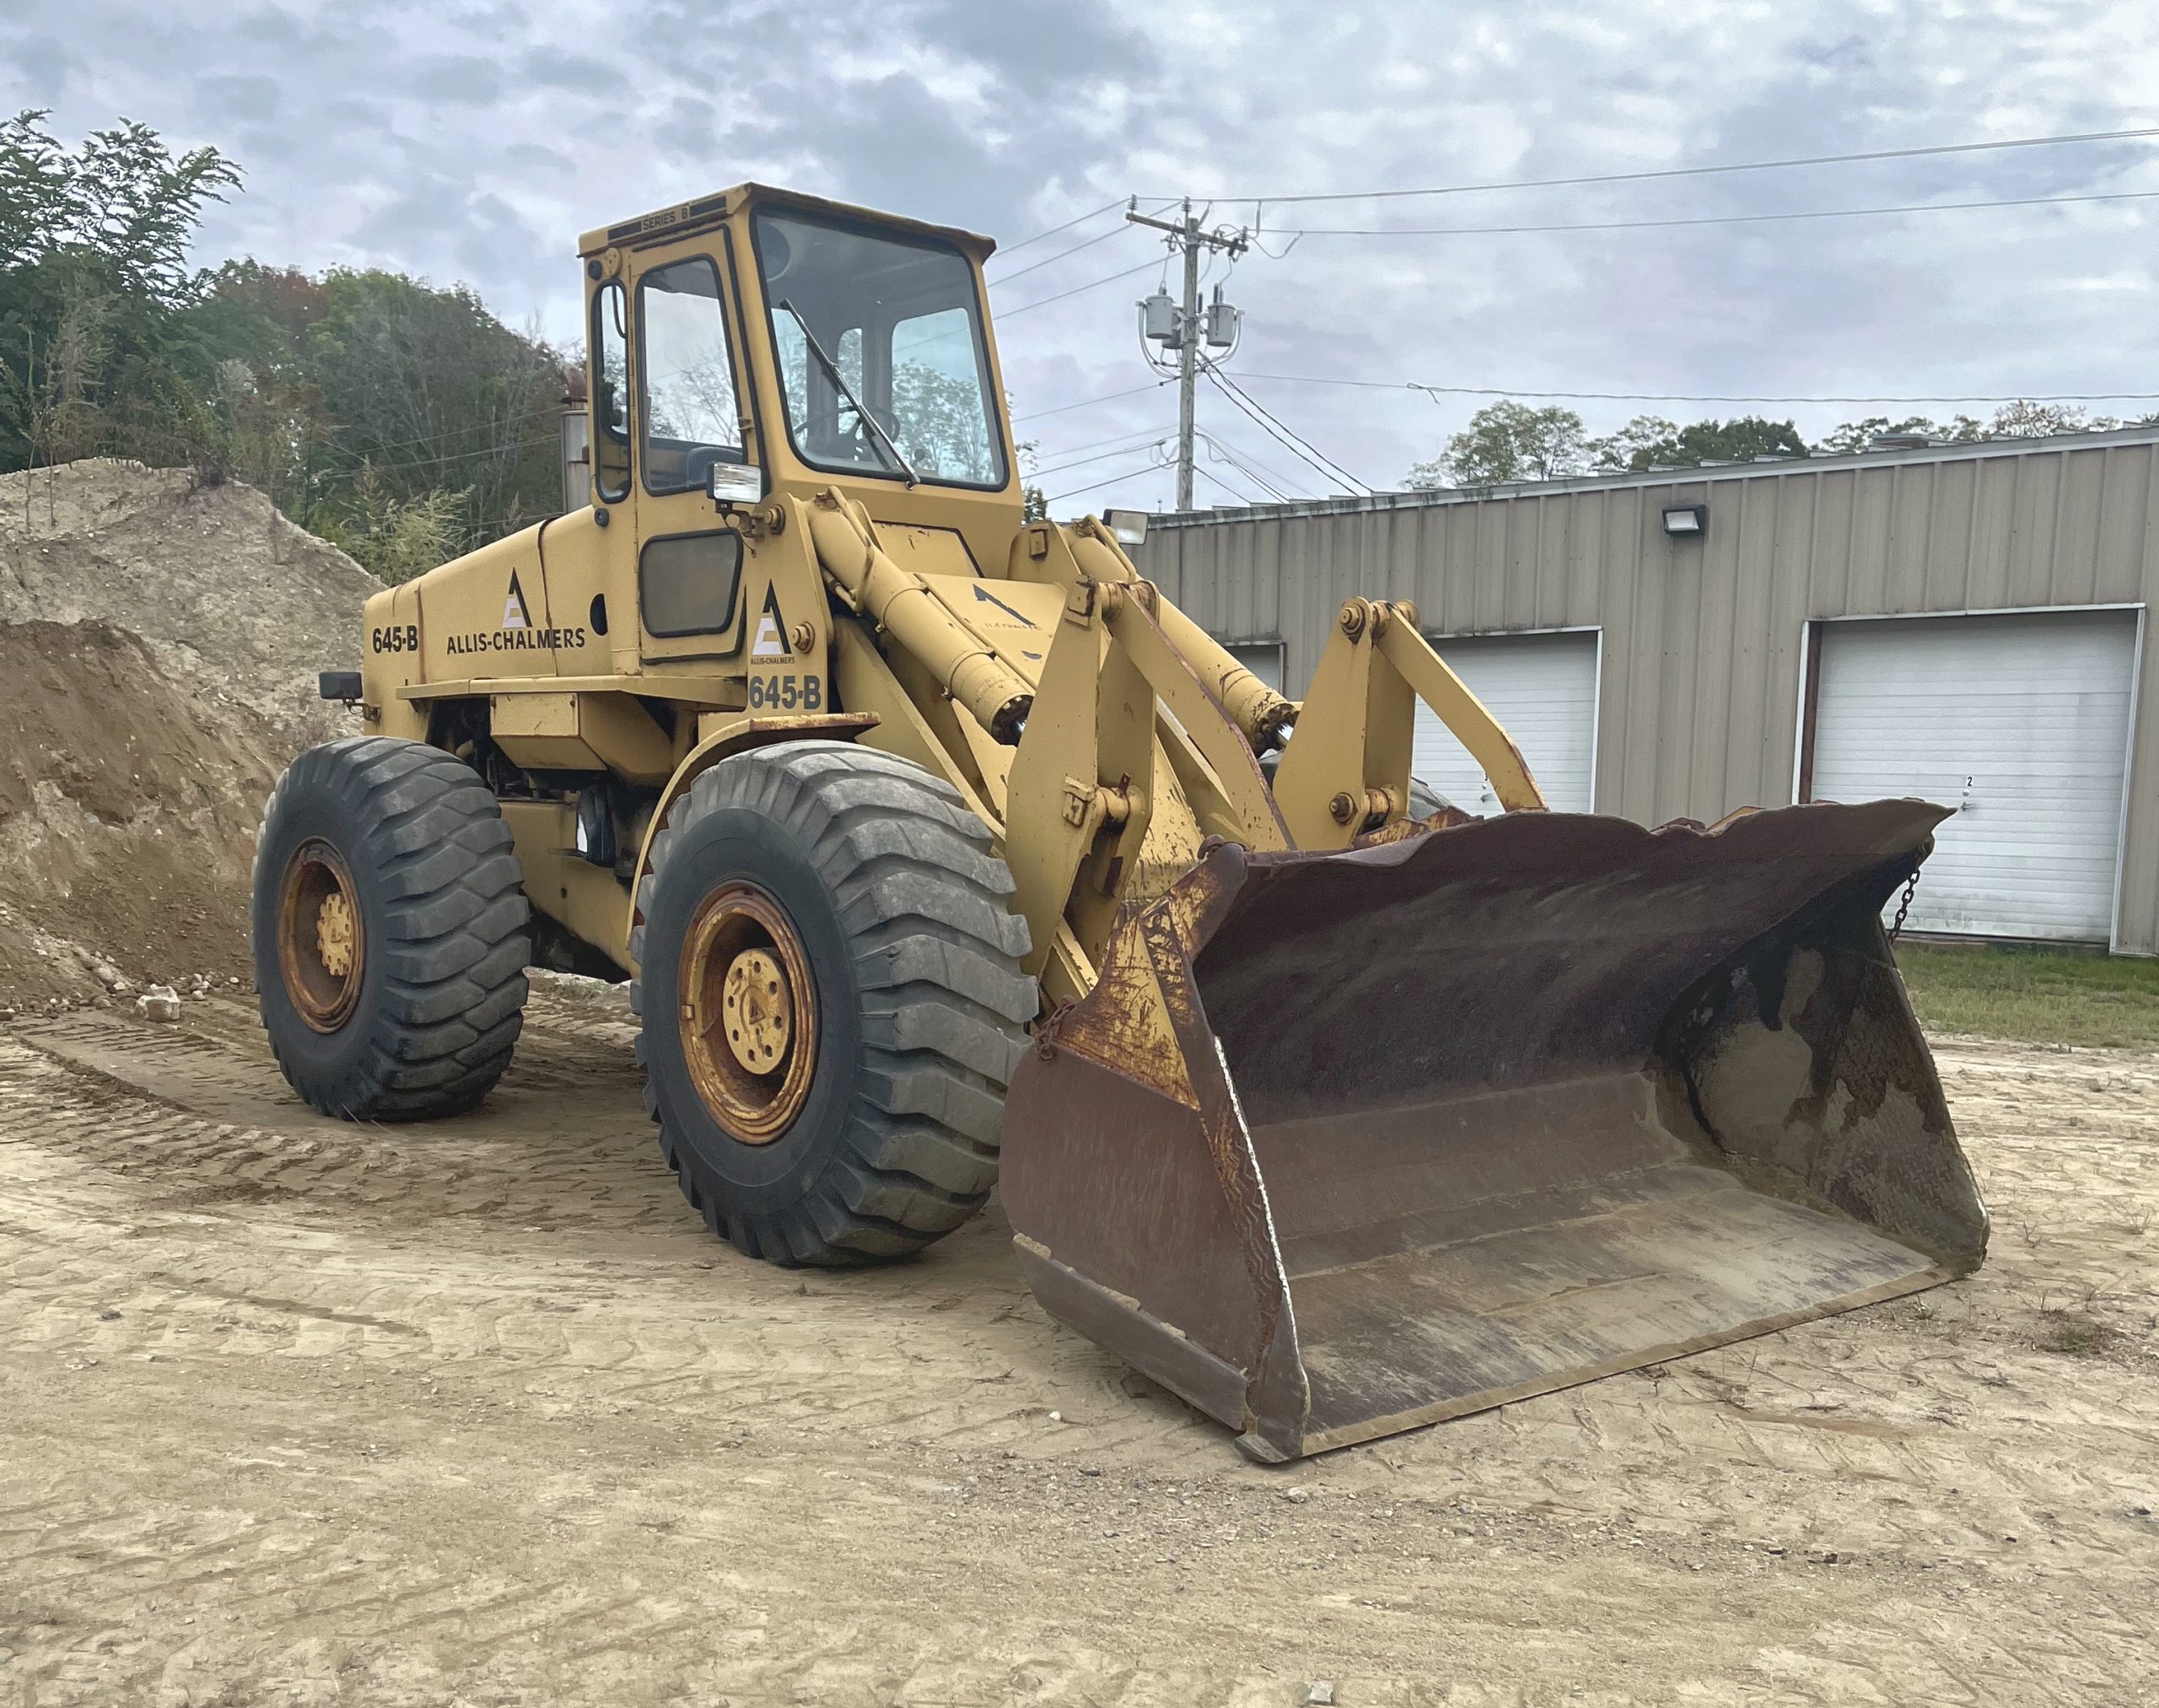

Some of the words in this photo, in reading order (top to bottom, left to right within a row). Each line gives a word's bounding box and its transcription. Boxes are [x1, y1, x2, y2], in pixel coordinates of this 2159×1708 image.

[643, 213, 676, 230] SERIES
[681, 207, 688, 218] B
[372, 625, 417, 654] 645-B
[447, 628, 585, 655] ALLIS-CHALMERS
[751, 656, 795, 665] ALLIS-CHALMERS
[749, 676, 821, 709] 645-B
[1967, 776, 1973, 787] 2
